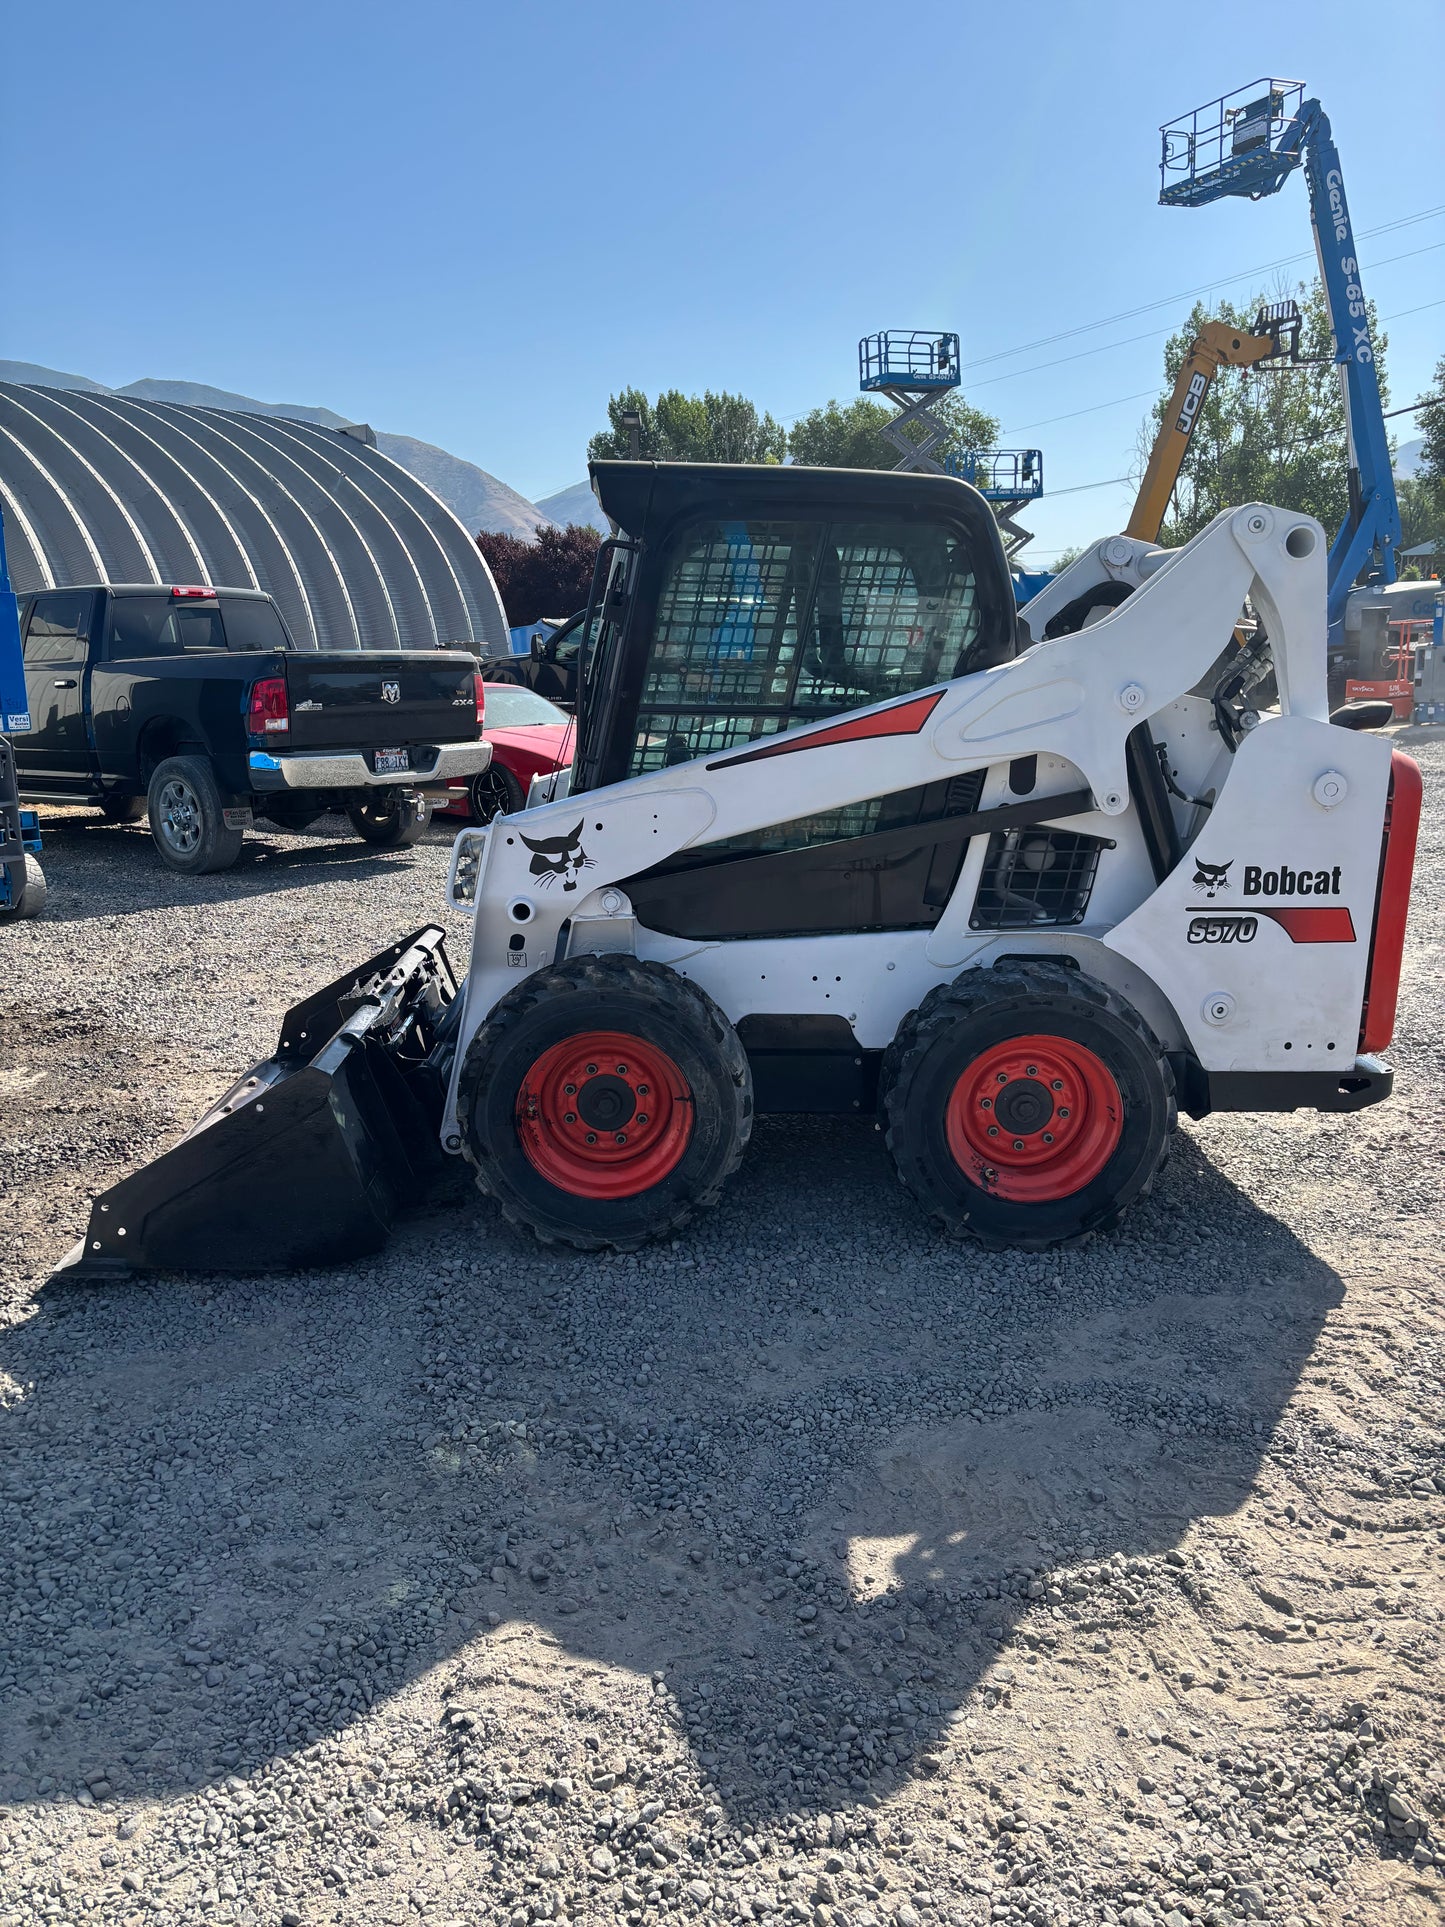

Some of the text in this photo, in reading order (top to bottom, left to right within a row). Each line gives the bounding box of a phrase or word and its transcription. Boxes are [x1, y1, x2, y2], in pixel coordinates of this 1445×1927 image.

[1326, 169, 1373, 364] Genie S-65 XC
[1180, 374, 1206, 433] JCB
[452, 698, 474, 706] 4X4
[1243, 865, 1342, 896] Bobcat
[1187, 916, 1259, 944] S570
